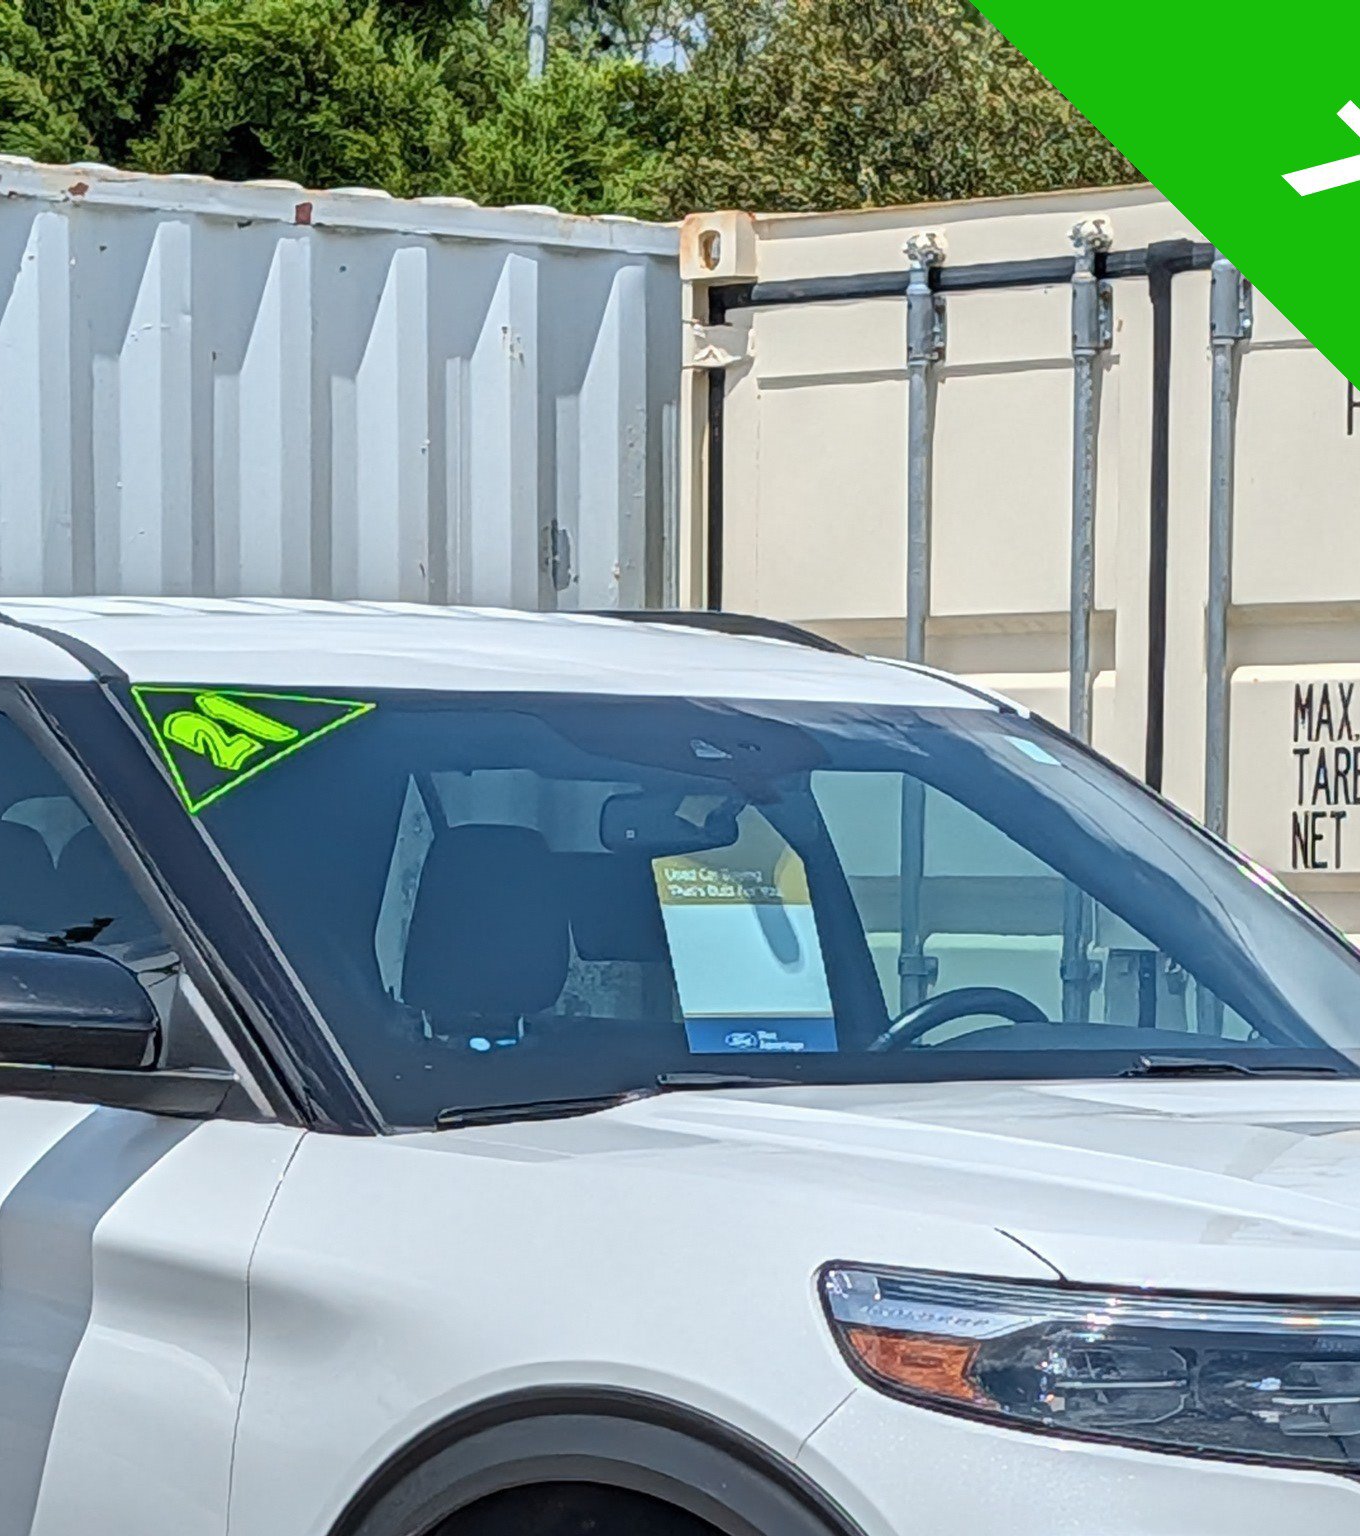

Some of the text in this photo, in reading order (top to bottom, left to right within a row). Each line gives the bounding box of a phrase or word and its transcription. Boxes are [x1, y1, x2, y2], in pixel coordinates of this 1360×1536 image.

[162, 692, 299, 771] 21
[1293, 682, 1360, 742] MAX.
[1292, 810, 1347, 869] NET
